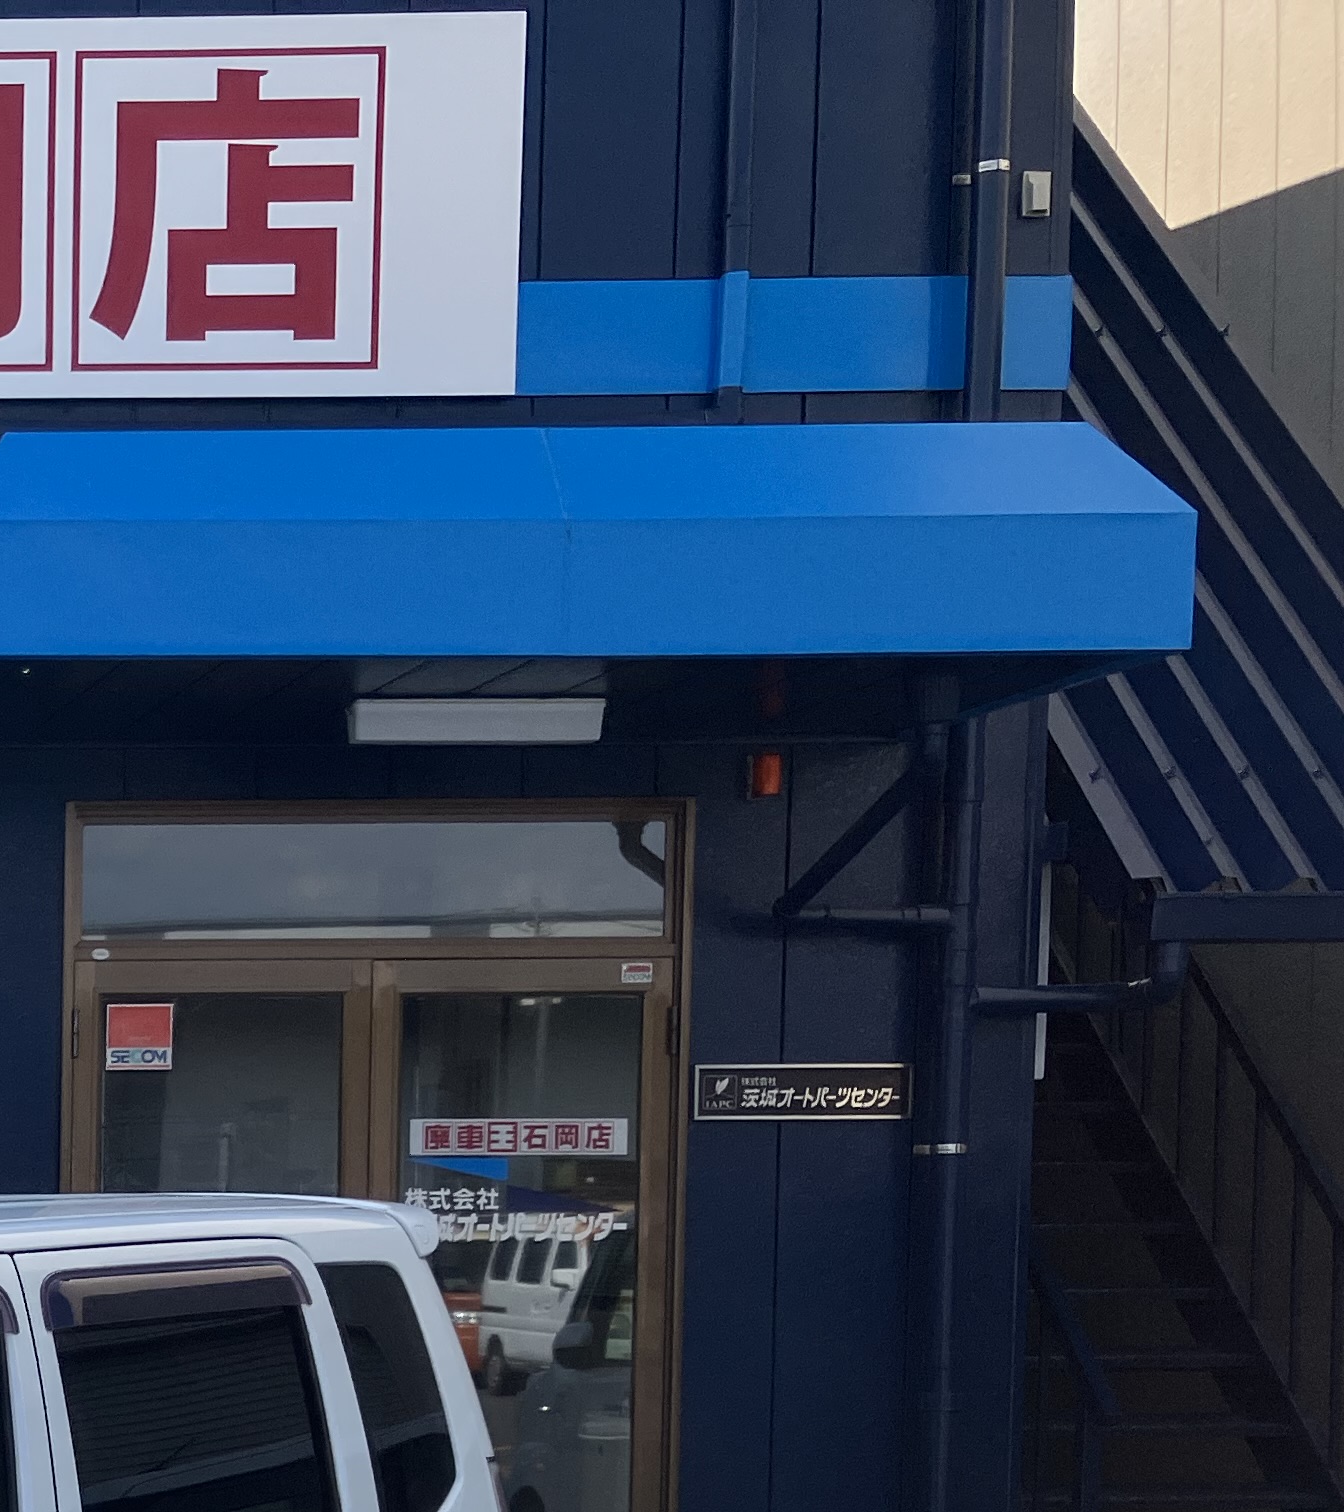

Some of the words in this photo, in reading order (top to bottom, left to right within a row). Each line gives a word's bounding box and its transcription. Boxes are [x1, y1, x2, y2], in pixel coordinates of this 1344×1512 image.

[110, 1049, 168, 1064] SECOM
[740, 1086, 900, 1109] 茨城オートパーツセンター
[404, 1187, 500, 1211] 株式会社
[433, 1212, 629, 1243] 城オートパーツセンター
